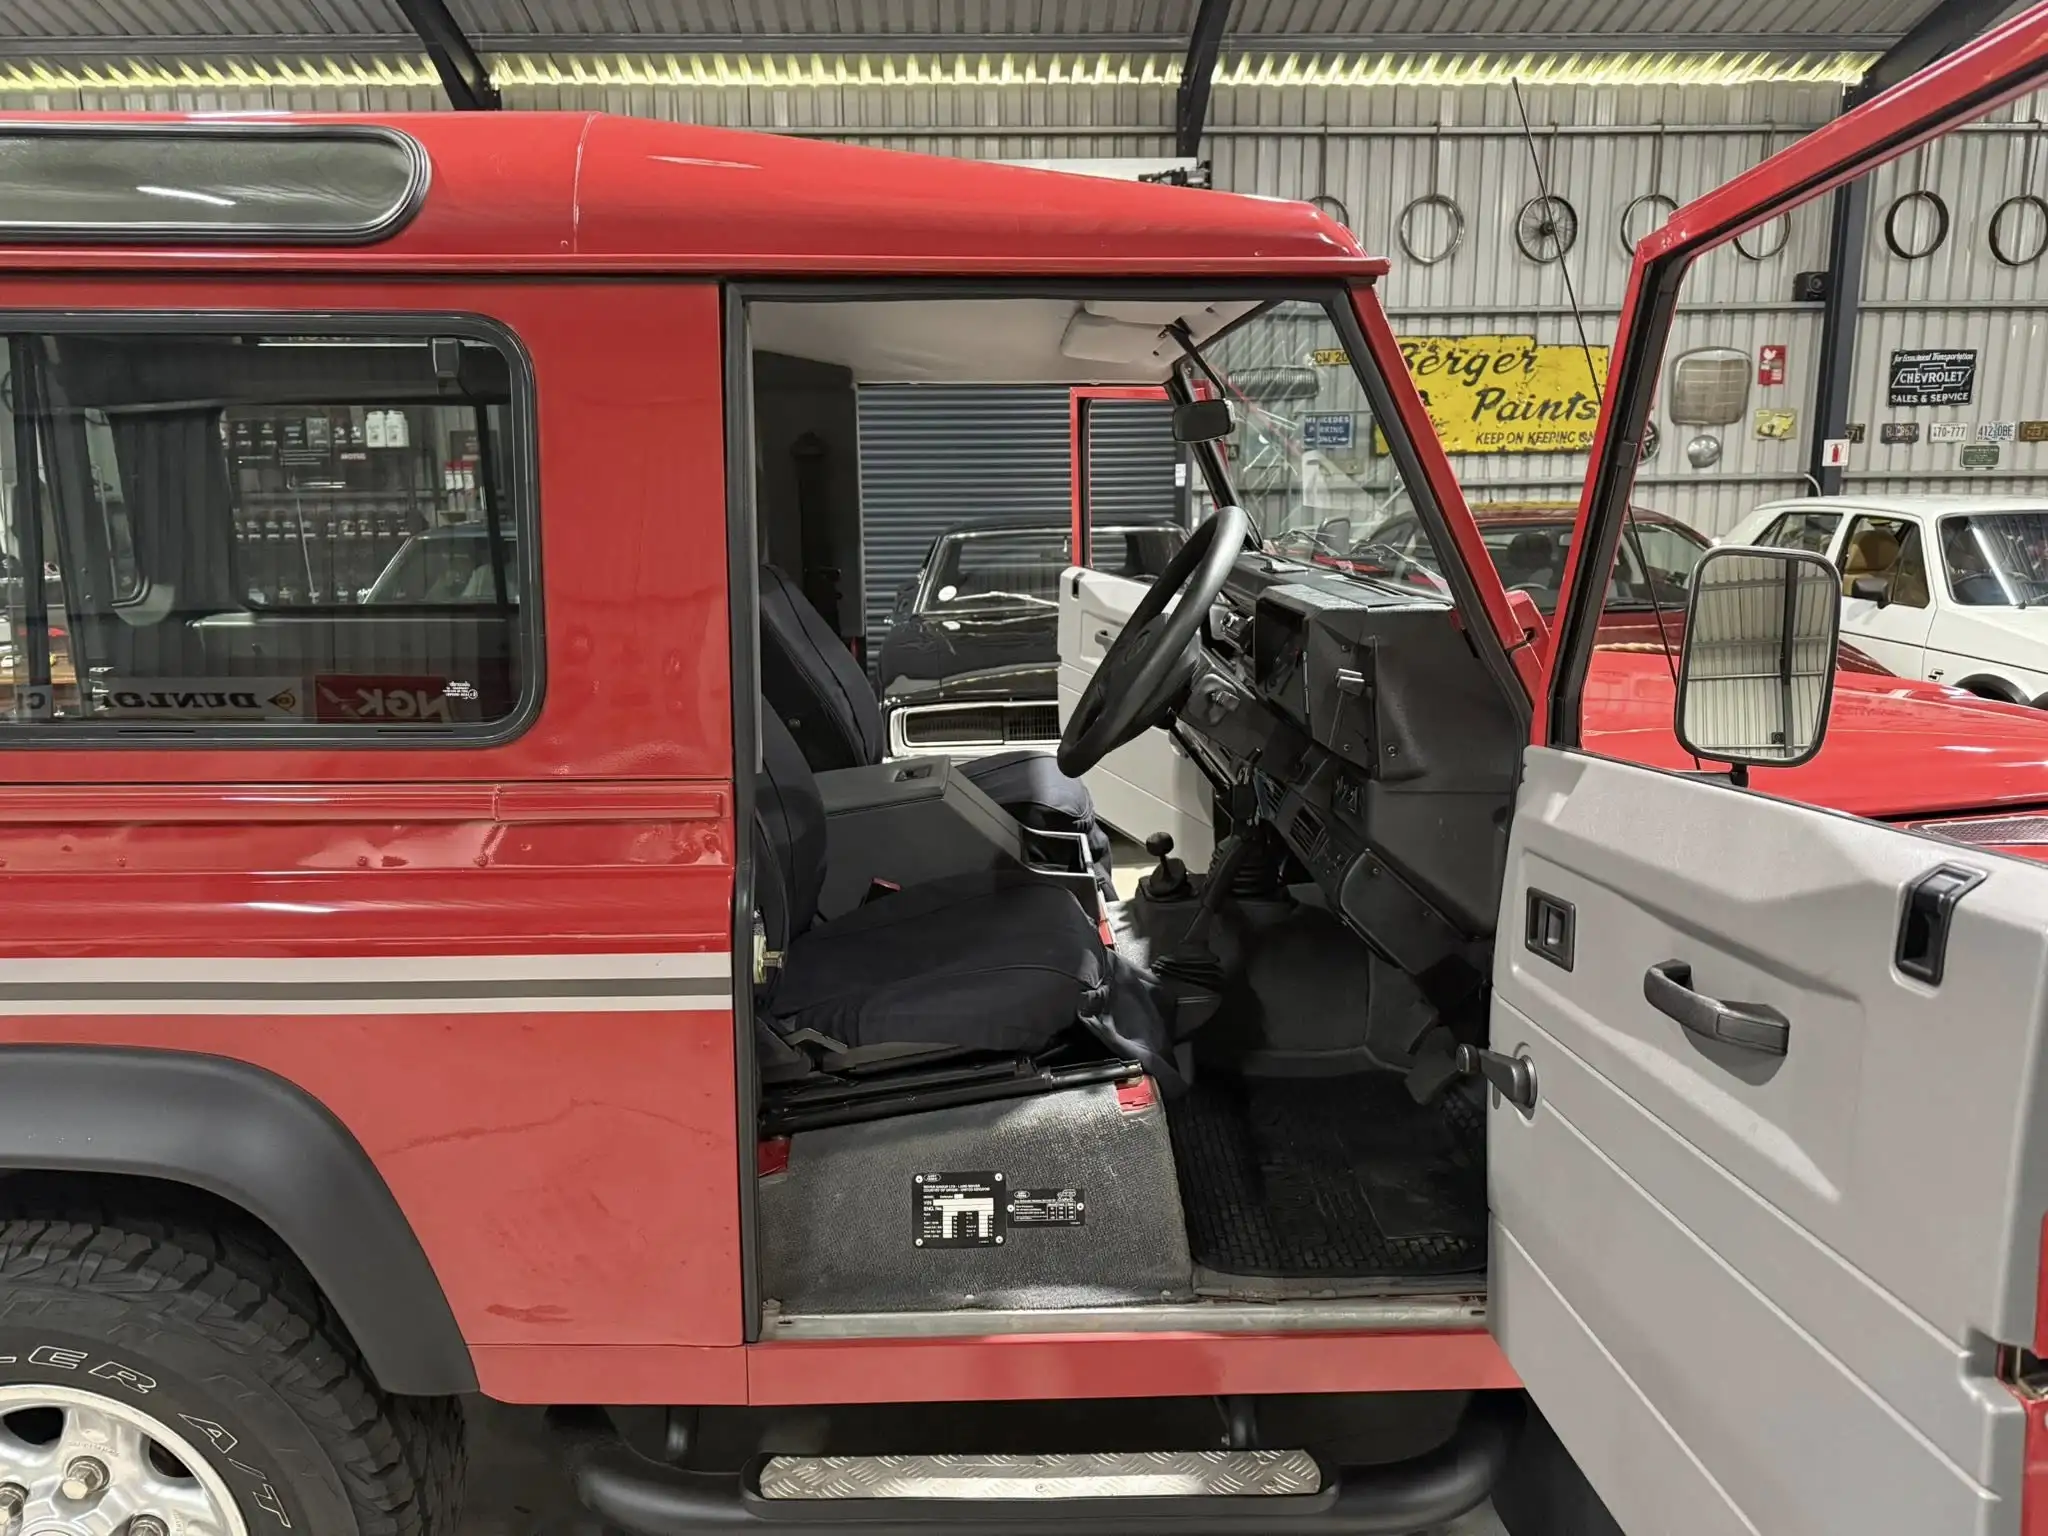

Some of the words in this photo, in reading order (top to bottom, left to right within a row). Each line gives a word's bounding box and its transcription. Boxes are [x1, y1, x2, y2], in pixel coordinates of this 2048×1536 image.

[1899, 371, 1964, 384] CHEVROLET
[1891, 394, 1918, 403] SALES
[1920, 394, 1928, 403] &
[1930, 392, 1969, 403] SERVICE
[1471, 387, 1599, 423] Paints
[1476, 432, 1504, 445] KEEP
[1507, 431, 1525, 444] ON
[1928, 668, 1944, 682] S
[177, 1412, 292, 1529] A/T
